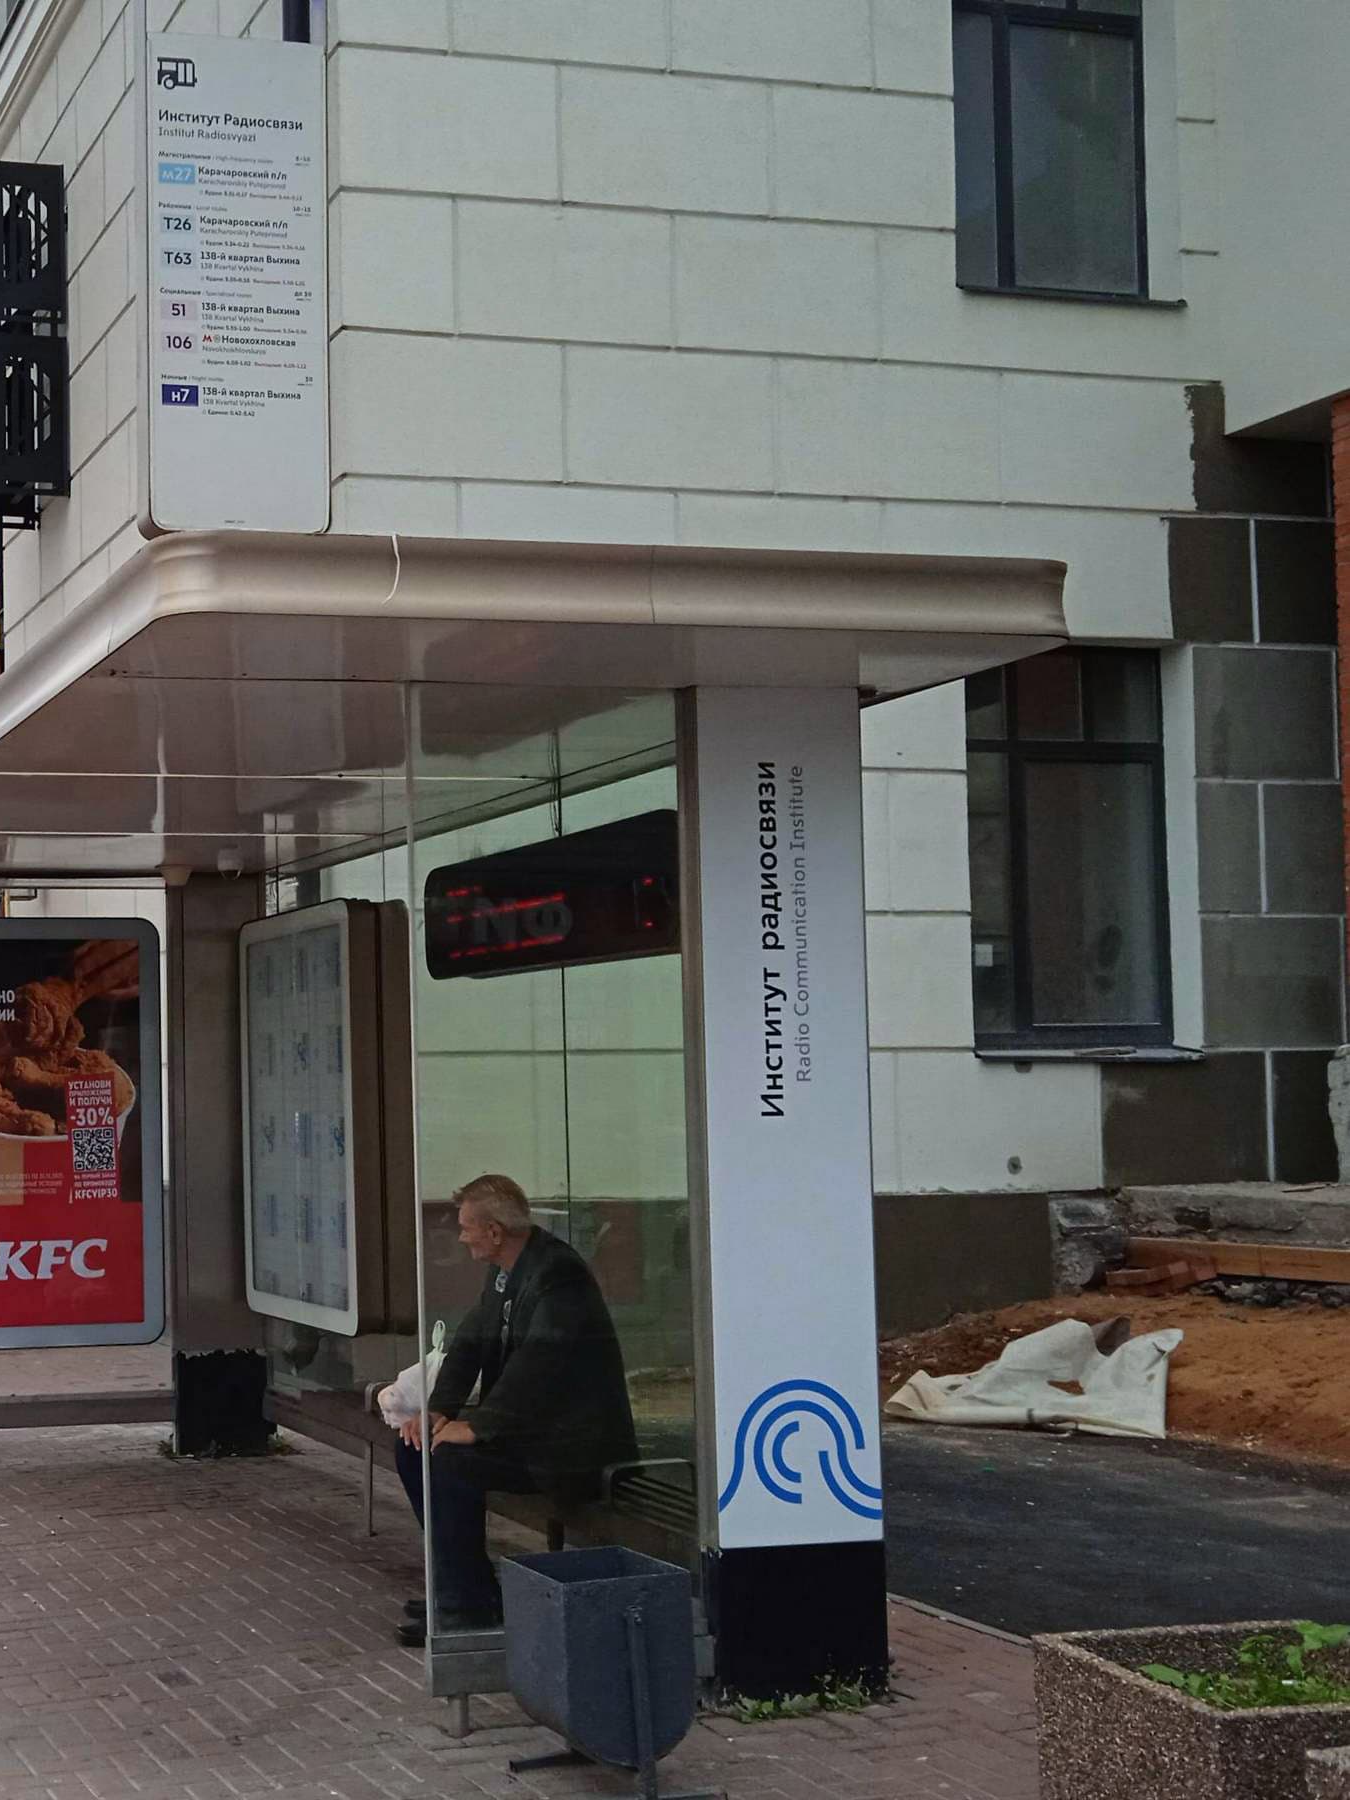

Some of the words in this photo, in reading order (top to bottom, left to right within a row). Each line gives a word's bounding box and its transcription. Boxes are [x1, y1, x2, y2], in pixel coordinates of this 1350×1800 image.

[158, 109, 220, 126] Институт
[224, 113, 303, 131] Радиосвязи
[158, 126, 195, 138] Institut
[197, 128, 256, 143] Radiosvyazi
[198, 166, 269, 181] Карачаровский
[270, 169, 287, 181] п/п
[200, 215, 271, 230] Карачаровский
[272, 219, 288, 230] п/п
[200, 250, 227, 261] 138-й
[228, 254, 265, 265] квартал
[266, 254, 301, 266] Выхина
[171, 303, 186, 317] 51
[201, 301, 227, 312] 138-й
[227, 305, 265, 316] квартал
[266, 305, 301, 316] Выхина
[165, 335, 193, 350] 106
[221, 335, 296, 348] Новохохловская
[202, 387, 228, 398] 138-й
[229, 389, 265, 400] квартал
[267, 390, 302, 401] Выхина
[787, 765, 805, 852] Institute
[758, 761, 785, 951] радиосвязи
[791, 860, 810, 1017] Communication
[761, 967, 787, 1118] Институт
[796, 1022, 811, 1082] Radio
[68, 1080, 112, 1090] УСТАНОВИ
[69, 1097, 76, 1106] И
[77, 1095, 113, 1106] ПОЛУЧИ
[70, 1107, 114, 1127] -30%
